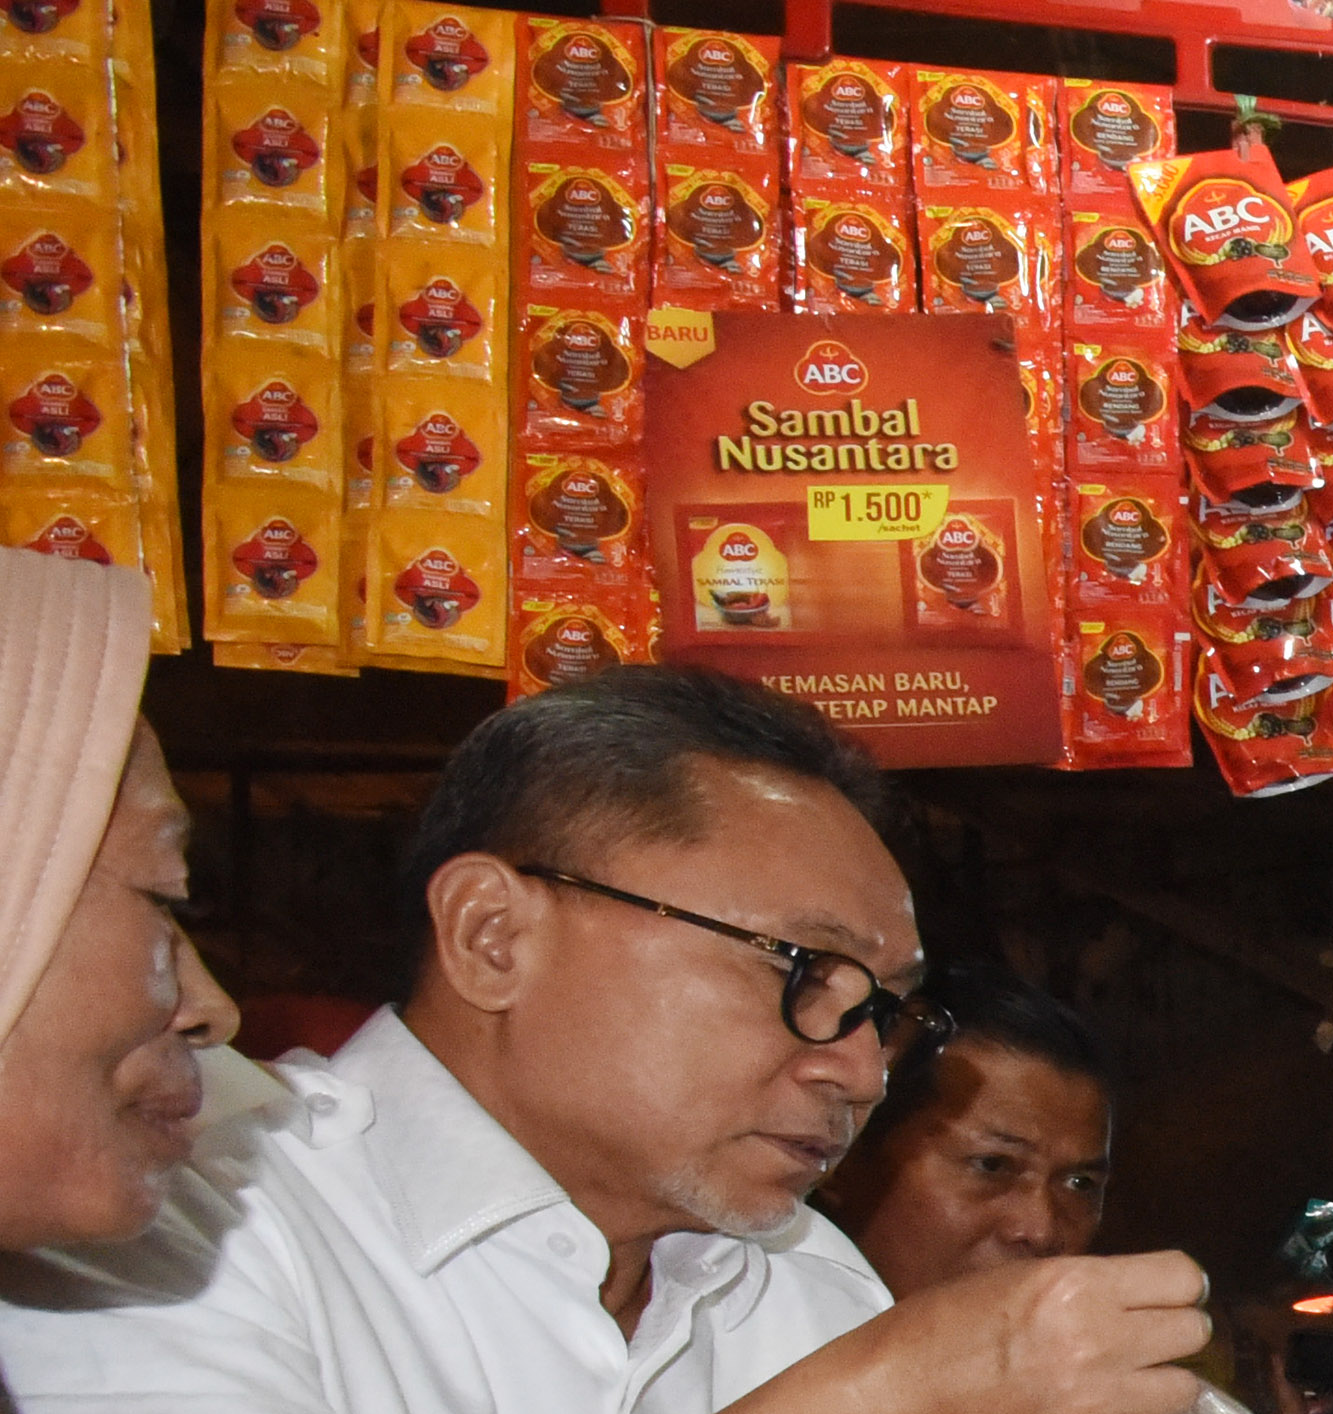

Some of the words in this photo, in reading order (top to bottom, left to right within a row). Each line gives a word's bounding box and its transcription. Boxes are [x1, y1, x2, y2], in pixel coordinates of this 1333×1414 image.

[955, 94, 982, 107] ABC
[429, 154, 460, 167] ABC
[430, 173, 457, 184] ASLI
[1184, 197, 1270, 242] ABC
[646, 323, 709, 344] BARU
[803, 361, 862, 386] ABC
[1110, 372, 1136, 382] ABC
[40, 384, 72, 397] ABC
[41, 405, 70, 415] ASLI
[747, 399, 922, 439] Sambal
[718, 434, 960, 472] Nusantara
[814, 491, 835, 509] RP
[263, 529, 294, 541] ABC
[942, 531, 975, 545] ABC
[264, 550, 290, 561] ASLI
[722, 544, 756, 557] ABC
[894, 671, 970, 693] BARU,
[897, 695, 998, 716] MANTAP
